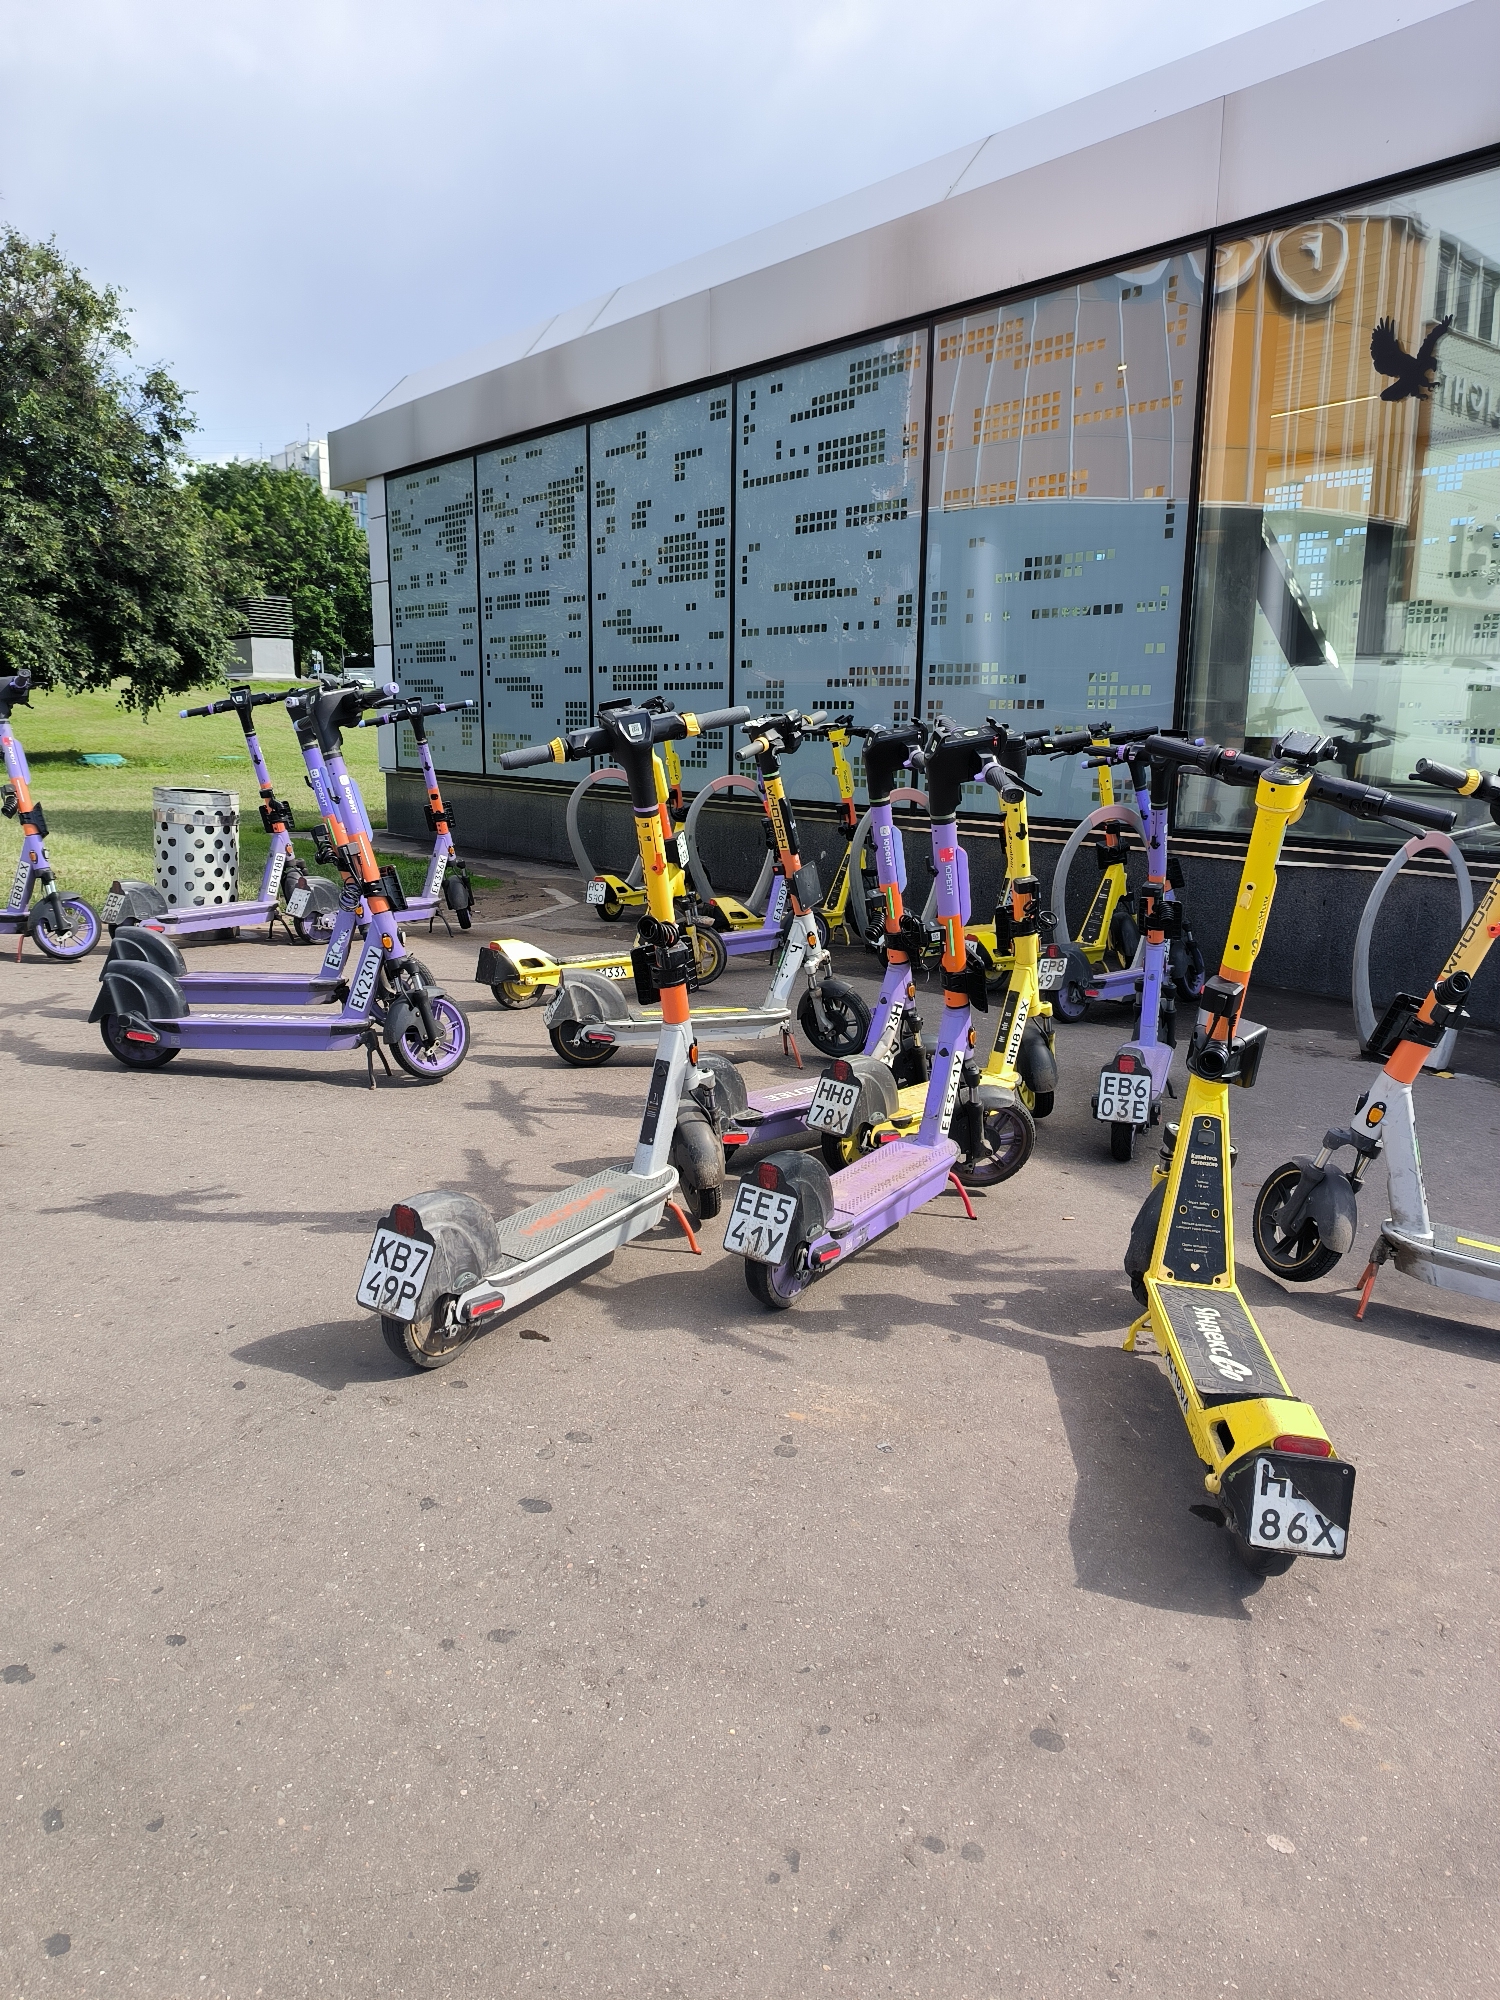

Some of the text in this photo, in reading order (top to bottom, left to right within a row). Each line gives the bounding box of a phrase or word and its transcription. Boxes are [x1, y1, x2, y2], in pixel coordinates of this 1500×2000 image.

[766, 784, 788, 850] WHOOSH
[1443, 878, 1500, 974] WHOOSH
[1192, 1305, 1233, 1358] Яндекс
